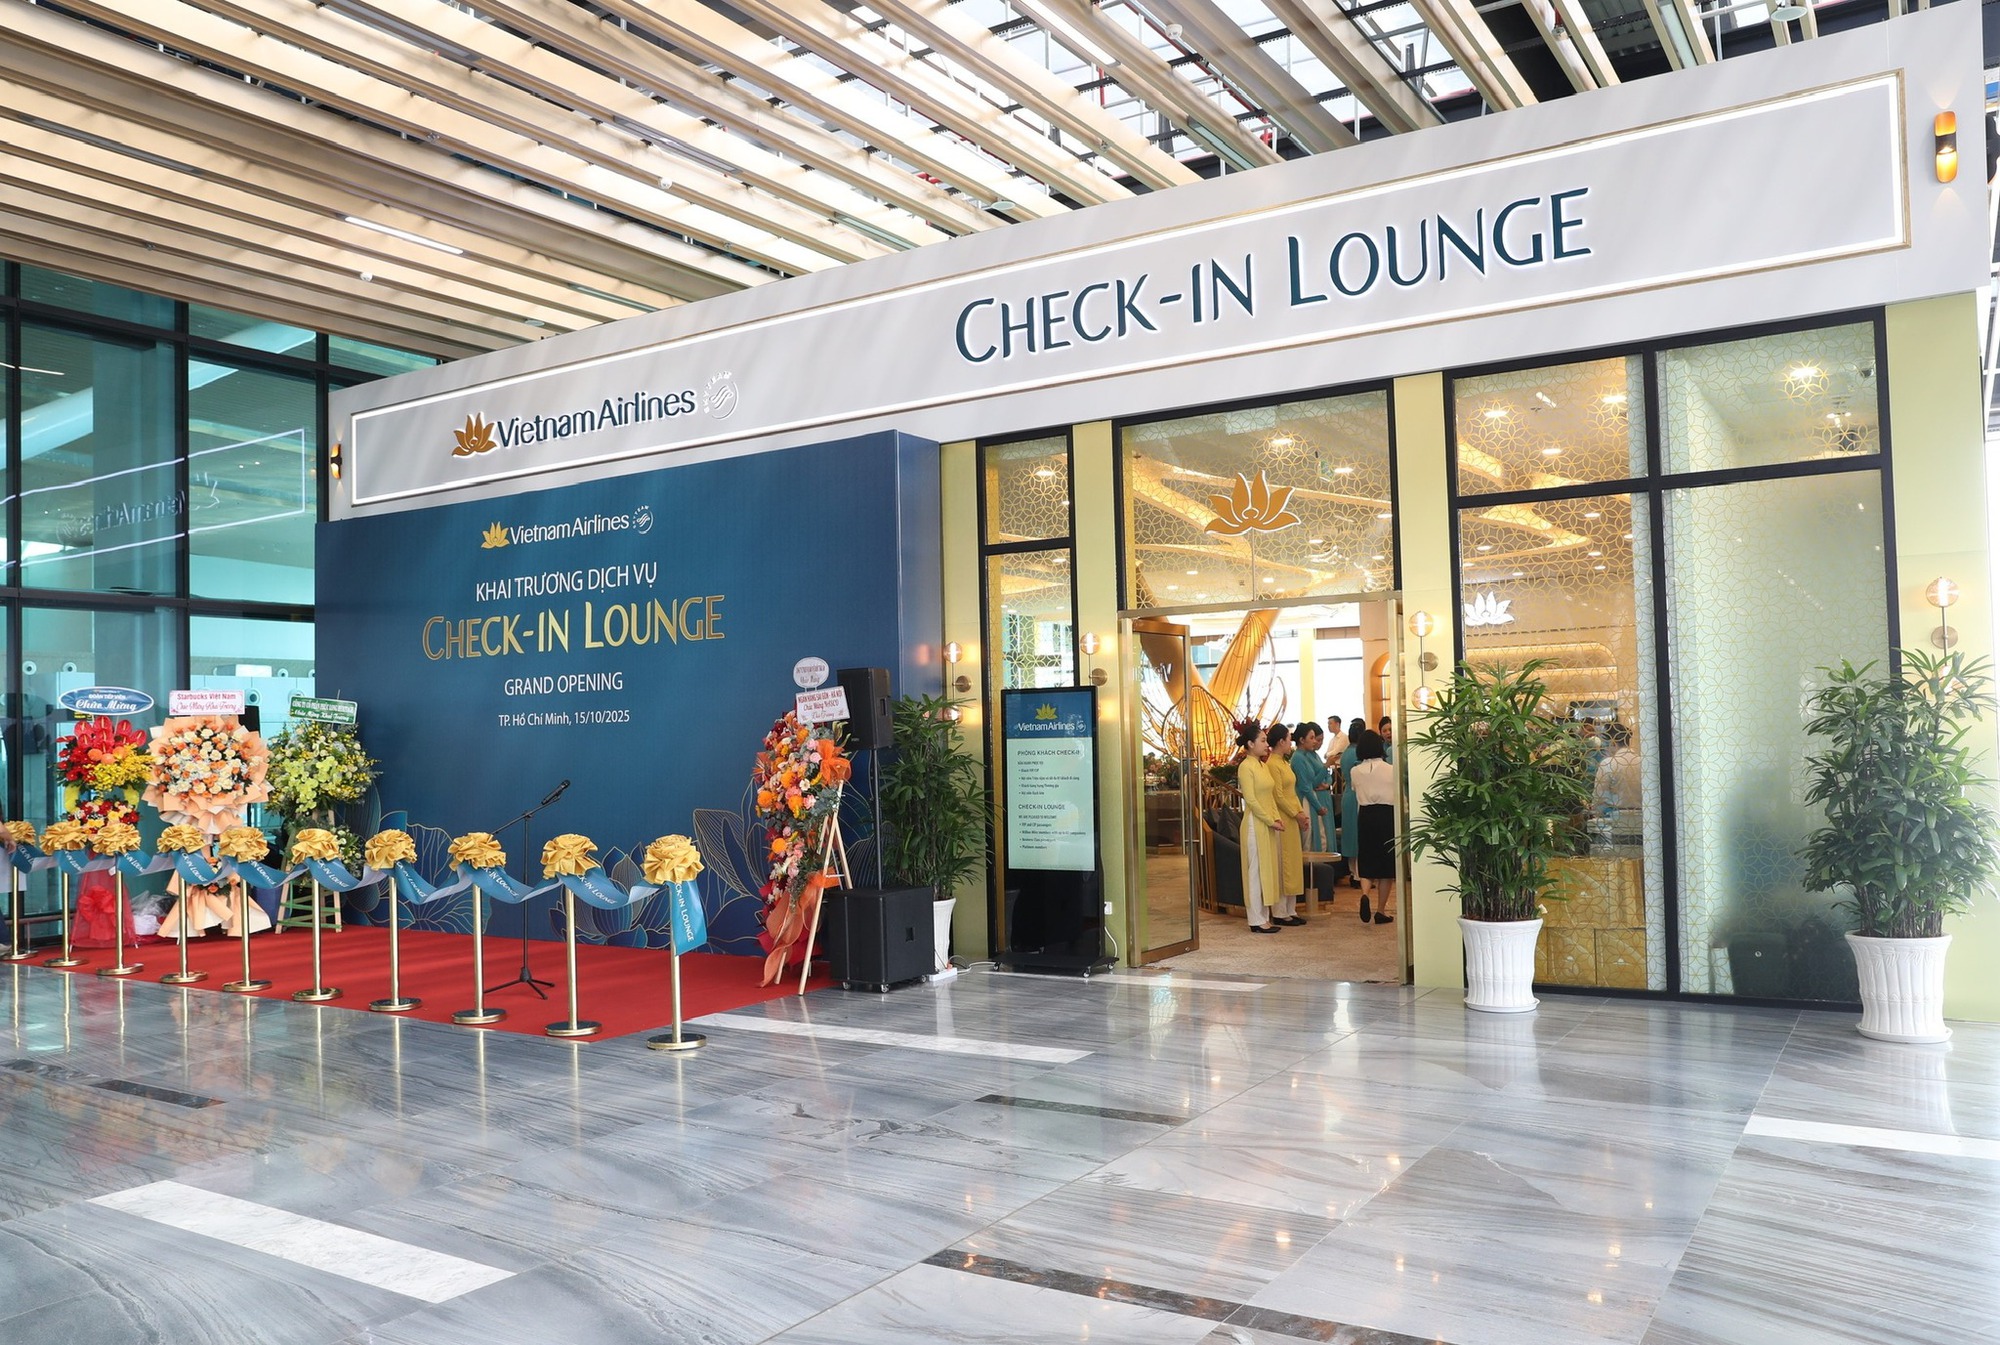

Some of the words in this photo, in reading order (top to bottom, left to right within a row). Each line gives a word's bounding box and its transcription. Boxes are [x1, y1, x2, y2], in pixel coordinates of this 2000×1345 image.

[1287, 186, 1593, 307] LOUNGE
[496, 409, 595, 448] Vietnam
[597, 389, 696, 429] Airlines
[510, 522, 571, 545] Vietnam
[571, 513, 631, 537] Airlines
[476, 578, 512, 602] KHAI
[514, 570, 583, 598] TRƯƠNG
[588, 564, 630, 594] DỊCH
[632, 561, 658, 589] VỤ
[584, 594, 726, 649] LOUNGE
[504, 675, 554, 696] GRAND
[557, 671, 624, 694] OPENING
[498, 713, 511, 727] TP.
[512, 713, 526, 726] Hồ
[527, 711, 543, 726] Chí
[544, 711, 572, 727] Minh,
[574, 709, 631, 725] 15/10/2025
[1017, 722, 1048, 732] Vietnam
[1047, 721, 1075, 731] Airlines
[1037, 748, 1056, 756] KHÁCH
[680, 908, 695, 943] LOUNGE
